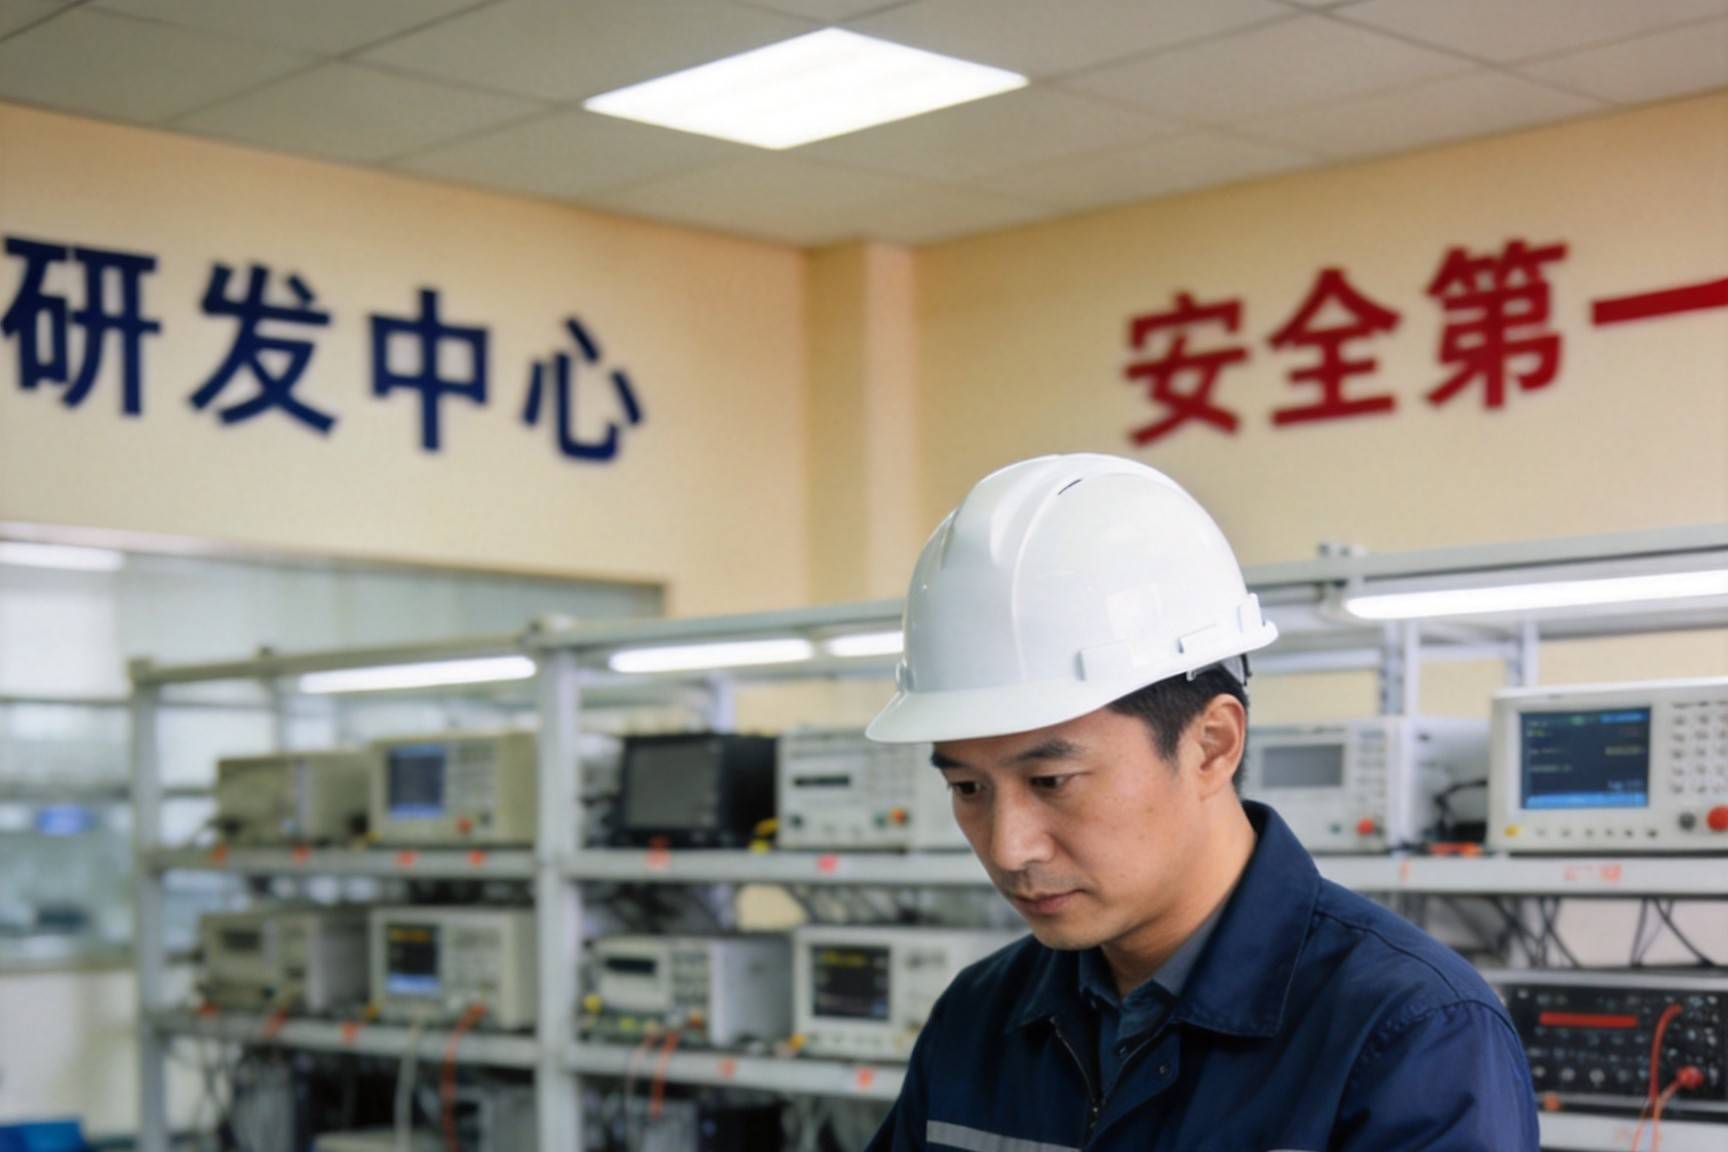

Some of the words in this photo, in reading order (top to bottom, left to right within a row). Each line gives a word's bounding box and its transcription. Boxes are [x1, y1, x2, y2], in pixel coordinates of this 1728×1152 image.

[0, 234, 644, 464] 研发中心
[1126, 240, 1728, 446] 安全第一
